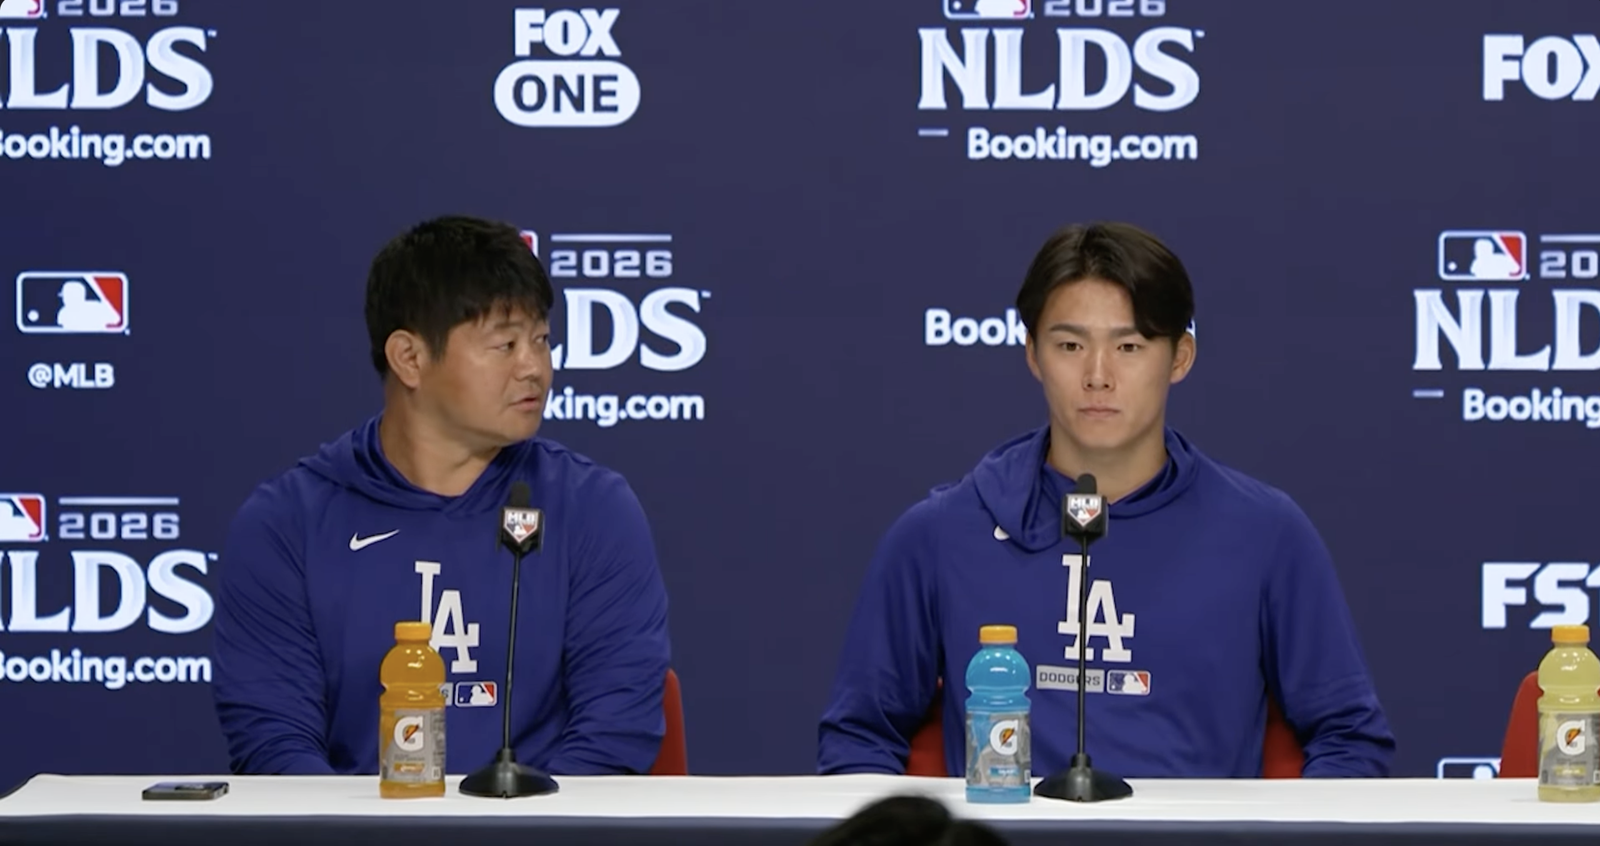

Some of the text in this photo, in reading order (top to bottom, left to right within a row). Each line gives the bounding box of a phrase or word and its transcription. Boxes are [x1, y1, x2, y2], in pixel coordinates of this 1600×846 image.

[58, 0, 177, 16] 2026
[1044, 0, 1166, 17] 2026
[514, 8, 621, 57] FOX
[0, 26, 213, 111] LDS
[917, 27, 1200, 111] NLDS
[512, 74, 619, 113] ONE
[0, 126, 211, 167] ooking.com
[967, 126, 1198, 168] Booking.com
[550, 250, 673, 278] 2026
[1540, 250, 1599, 278] 20
[551, 287, 708, 371] DS
[28, 362, 115, 389] @MLB
[59, 512, 179, 539] 2026
[0, 549, 216, 634] LDS
[1057, 554, 1135, 663] LA
[415, 561, 480, 674] LA
[0, 648, 212, 690] ooking.com
[1039, 671, 1101, 687] DODGRS
[394, 715, 424, 752] G
[989, 719, 1019, 755] G
[1556, 719, 1586, 756] G
